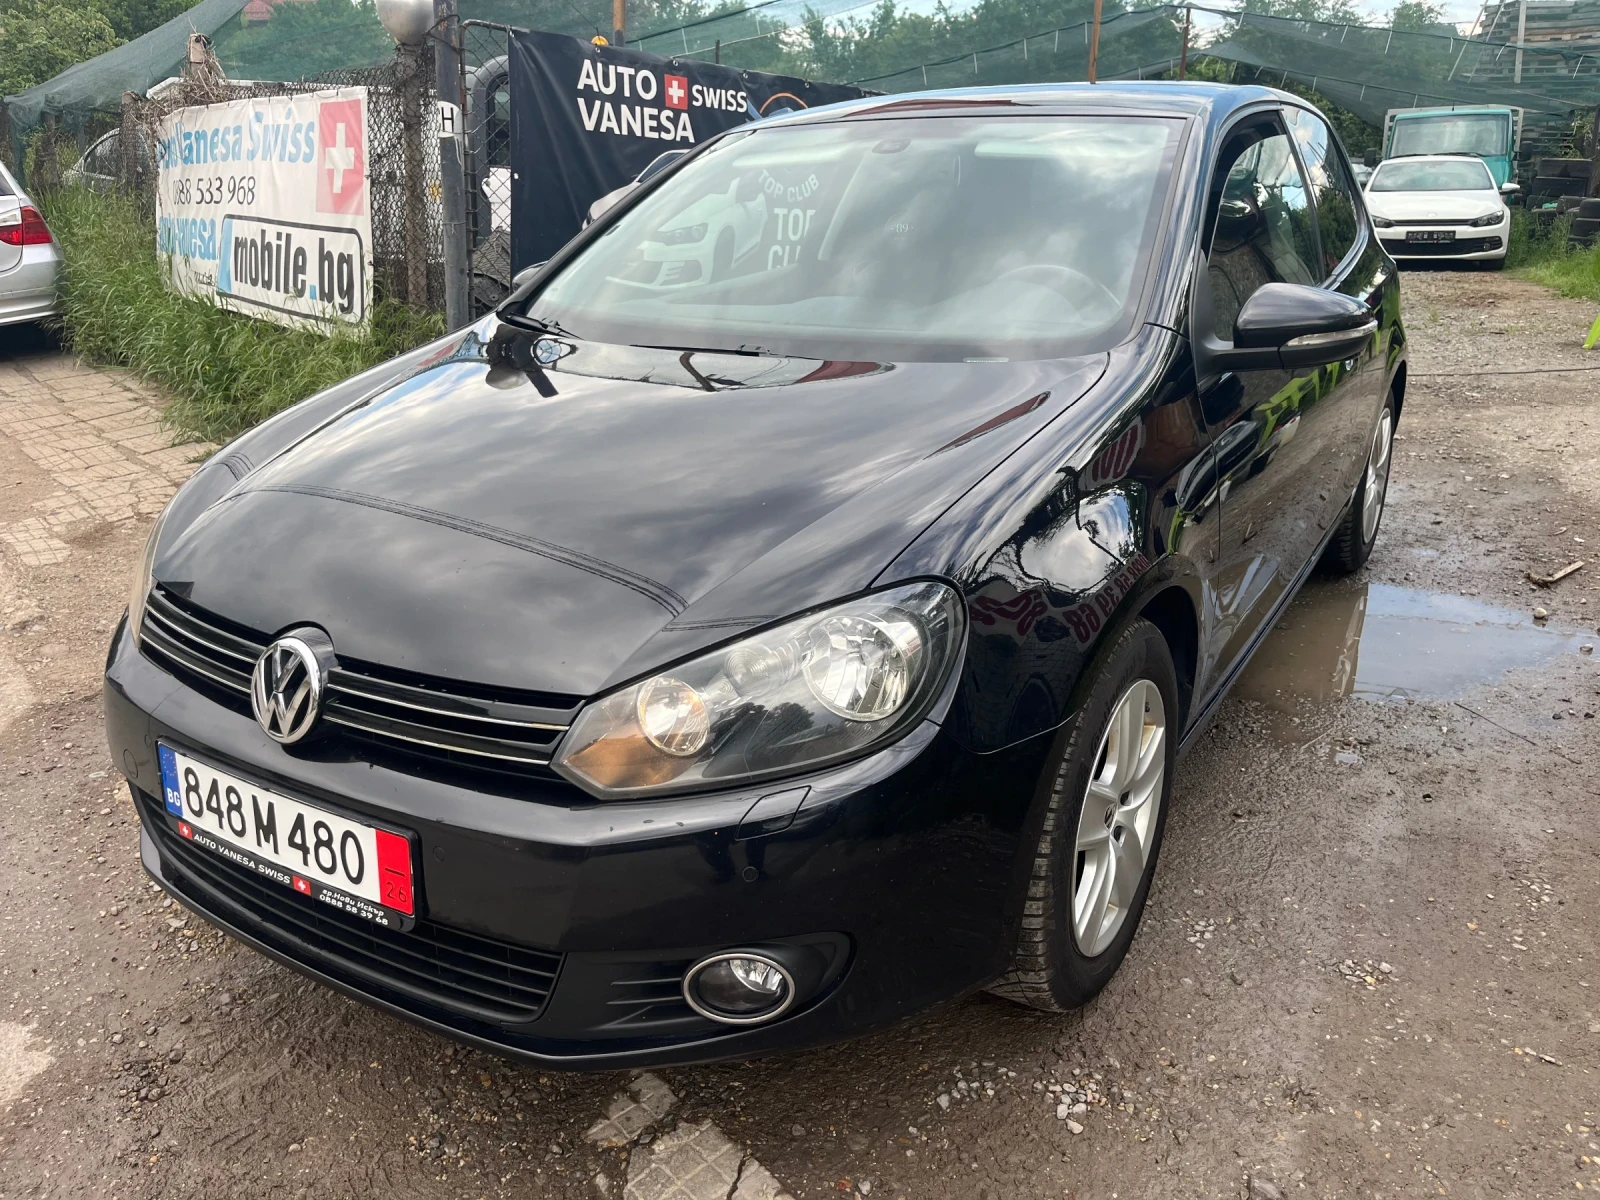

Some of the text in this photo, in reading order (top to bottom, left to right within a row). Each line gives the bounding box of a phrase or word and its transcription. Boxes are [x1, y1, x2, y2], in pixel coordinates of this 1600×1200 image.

[577, 59, 658, 100] AUTO
[692, 84, 748, 113] SWISS
[247, 107, 315, 164] Swiss
[577, 97, 696, 143] VANESA
[227, 175, 256, 205] 968
[758, 169, 819, 202] TOP CLUB
[234, 228, 355, 314] mobile.bg
[167, 787, 181, 806] BG
[194, 833, 291, 884] AUTO VANESA SWISS
[386, 881, 407, 903] 26
[319, 894, 389, 926] 0888 58 39 68
